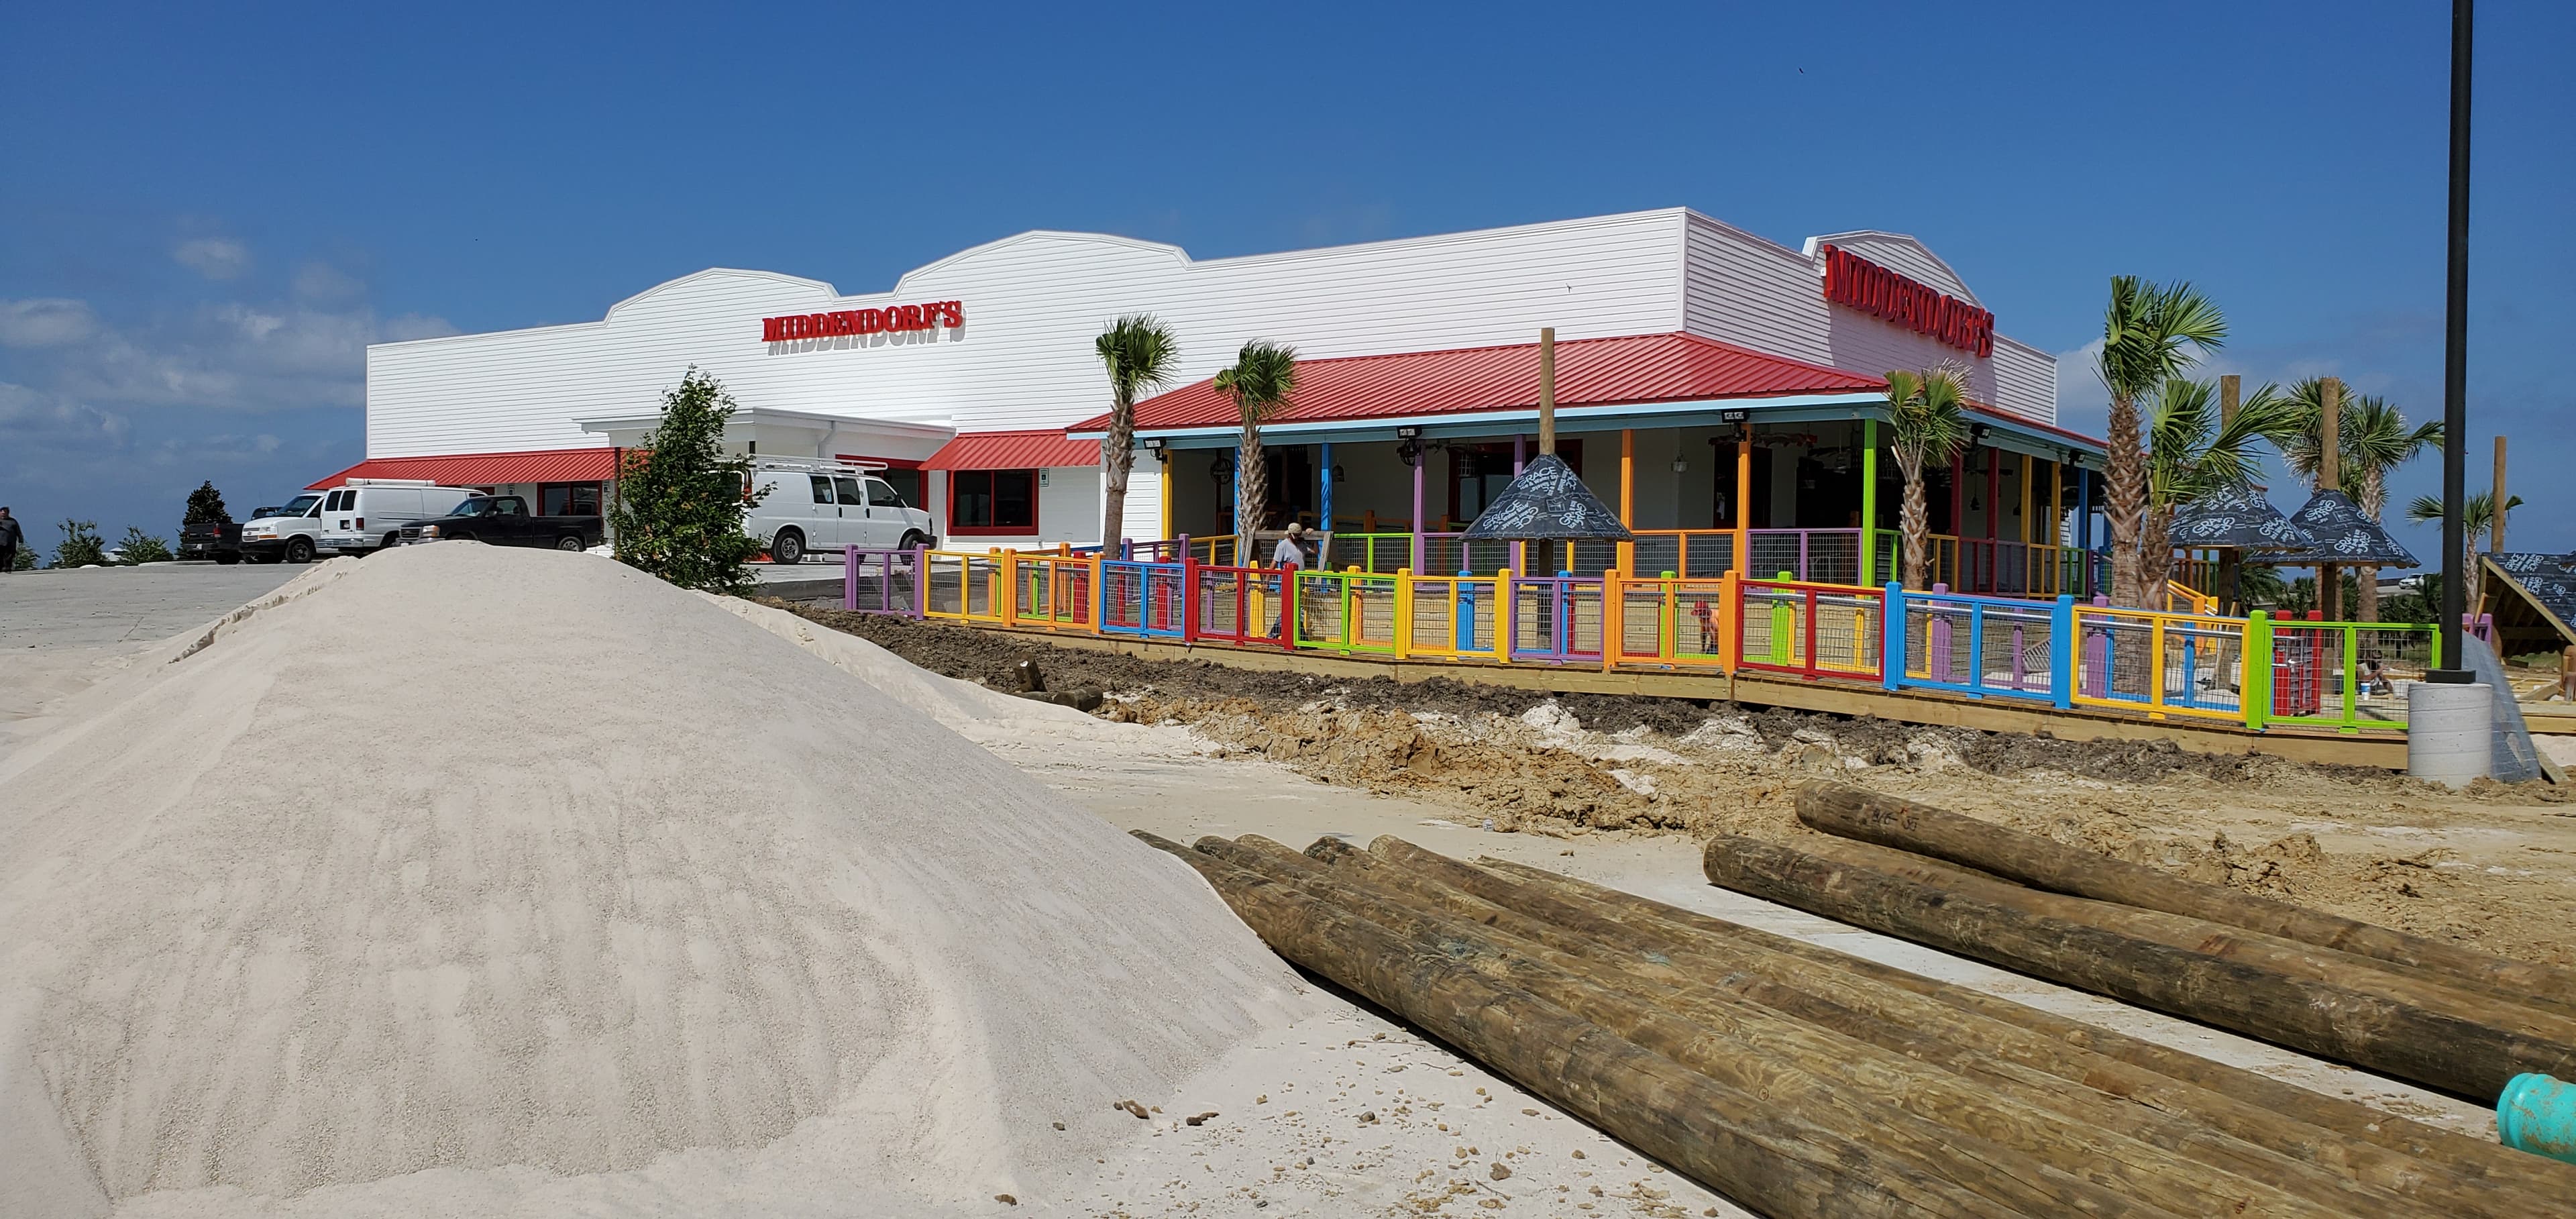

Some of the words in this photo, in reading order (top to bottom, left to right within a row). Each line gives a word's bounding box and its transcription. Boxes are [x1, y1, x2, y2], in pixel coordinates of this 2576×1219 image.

[761, 301, 963, 342] MIDDENDORF'S
[1823, 244, 1994, 358] MIDDENDORF'S
[1517, 466, 1558, 488] GRACE
